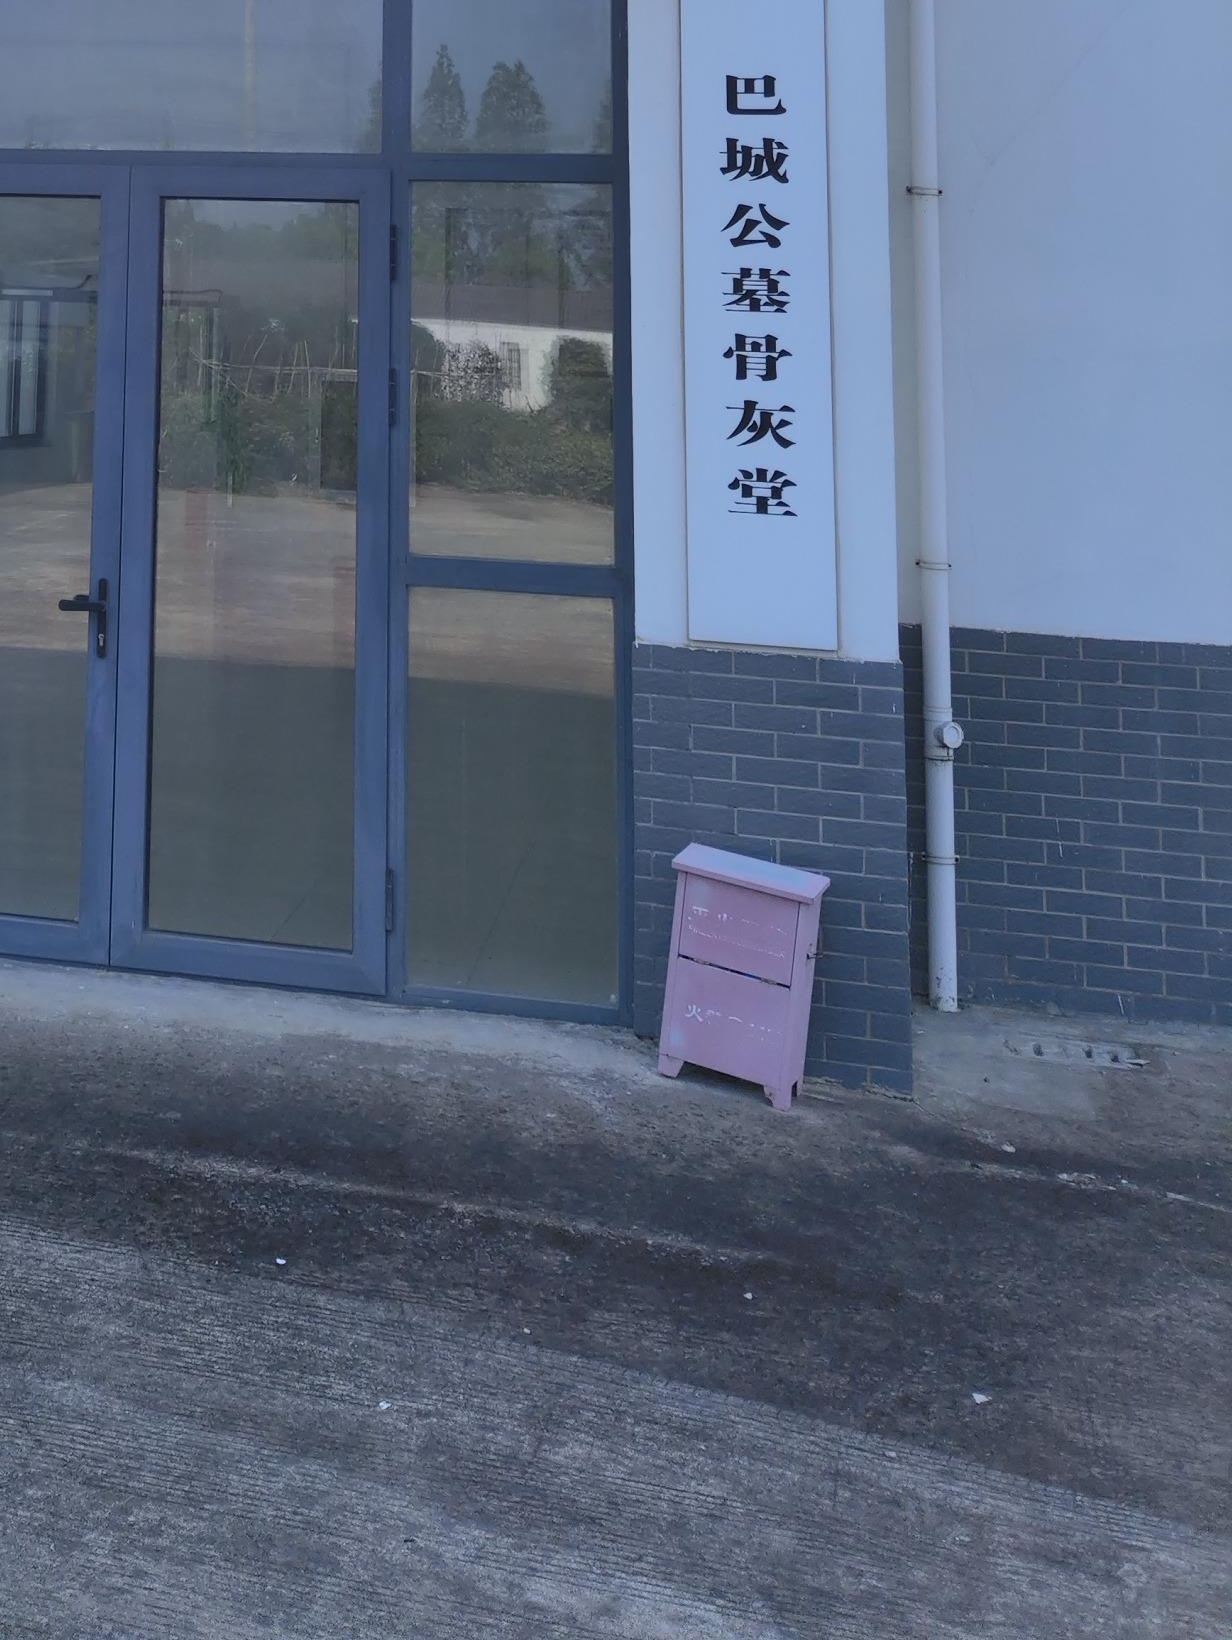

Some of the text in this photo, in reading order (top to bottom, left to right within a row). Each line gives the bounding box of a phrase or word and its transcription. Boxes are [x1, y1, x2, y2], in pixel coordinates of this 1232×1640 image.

[719, 74, 798, 518] 巴城公墓骨灰堂
